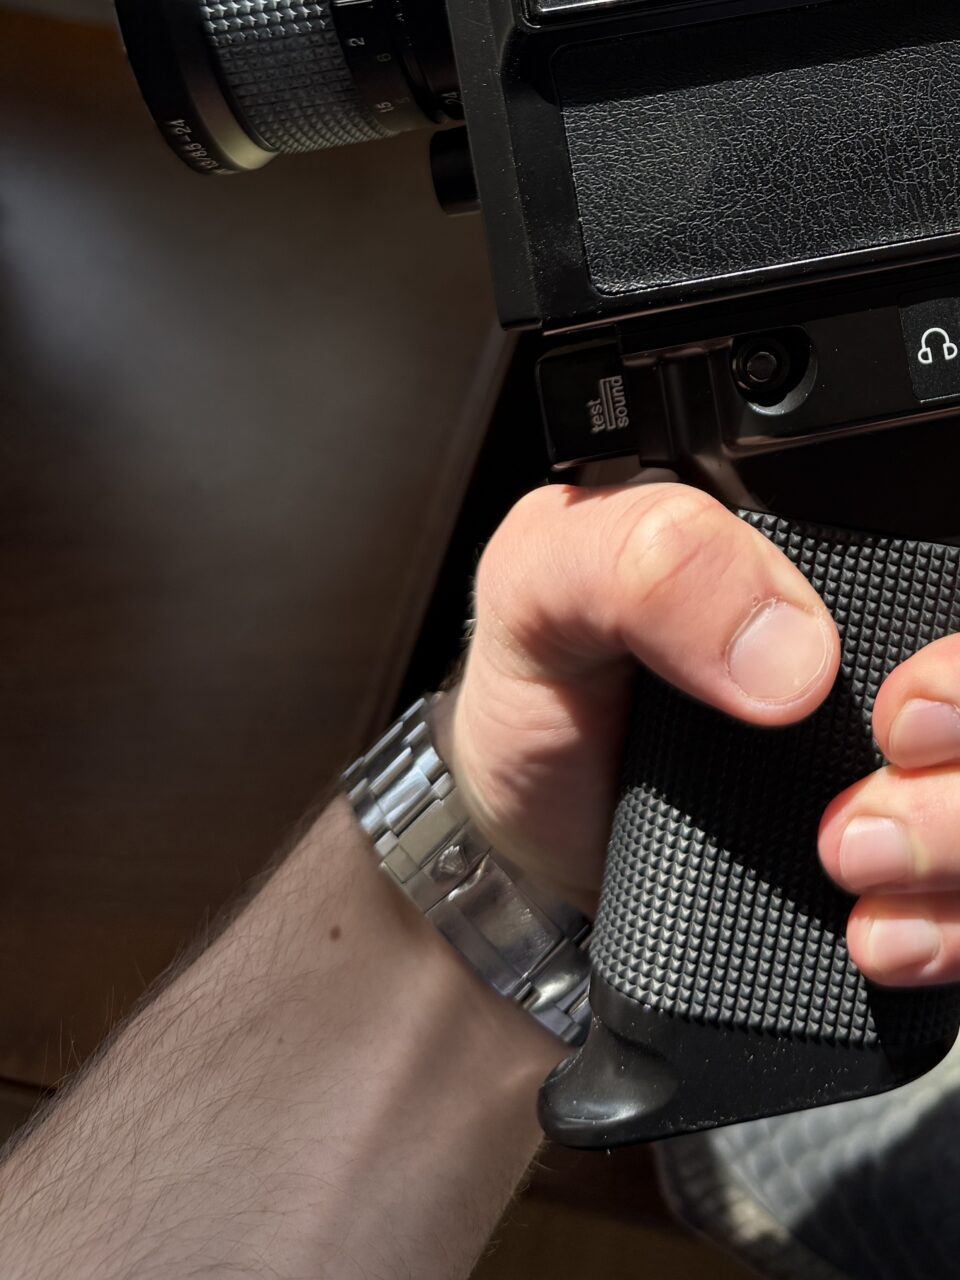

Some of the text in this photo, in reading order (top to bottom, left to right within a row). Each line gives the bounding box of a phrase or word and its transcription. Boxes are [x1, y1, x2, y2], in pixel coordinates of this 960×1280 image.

[347, 37, 366, 47] 2
[376, 52, 392, 63] 6
[605, 374, 630, 429] sound
[584, 398, 606, 434] test
